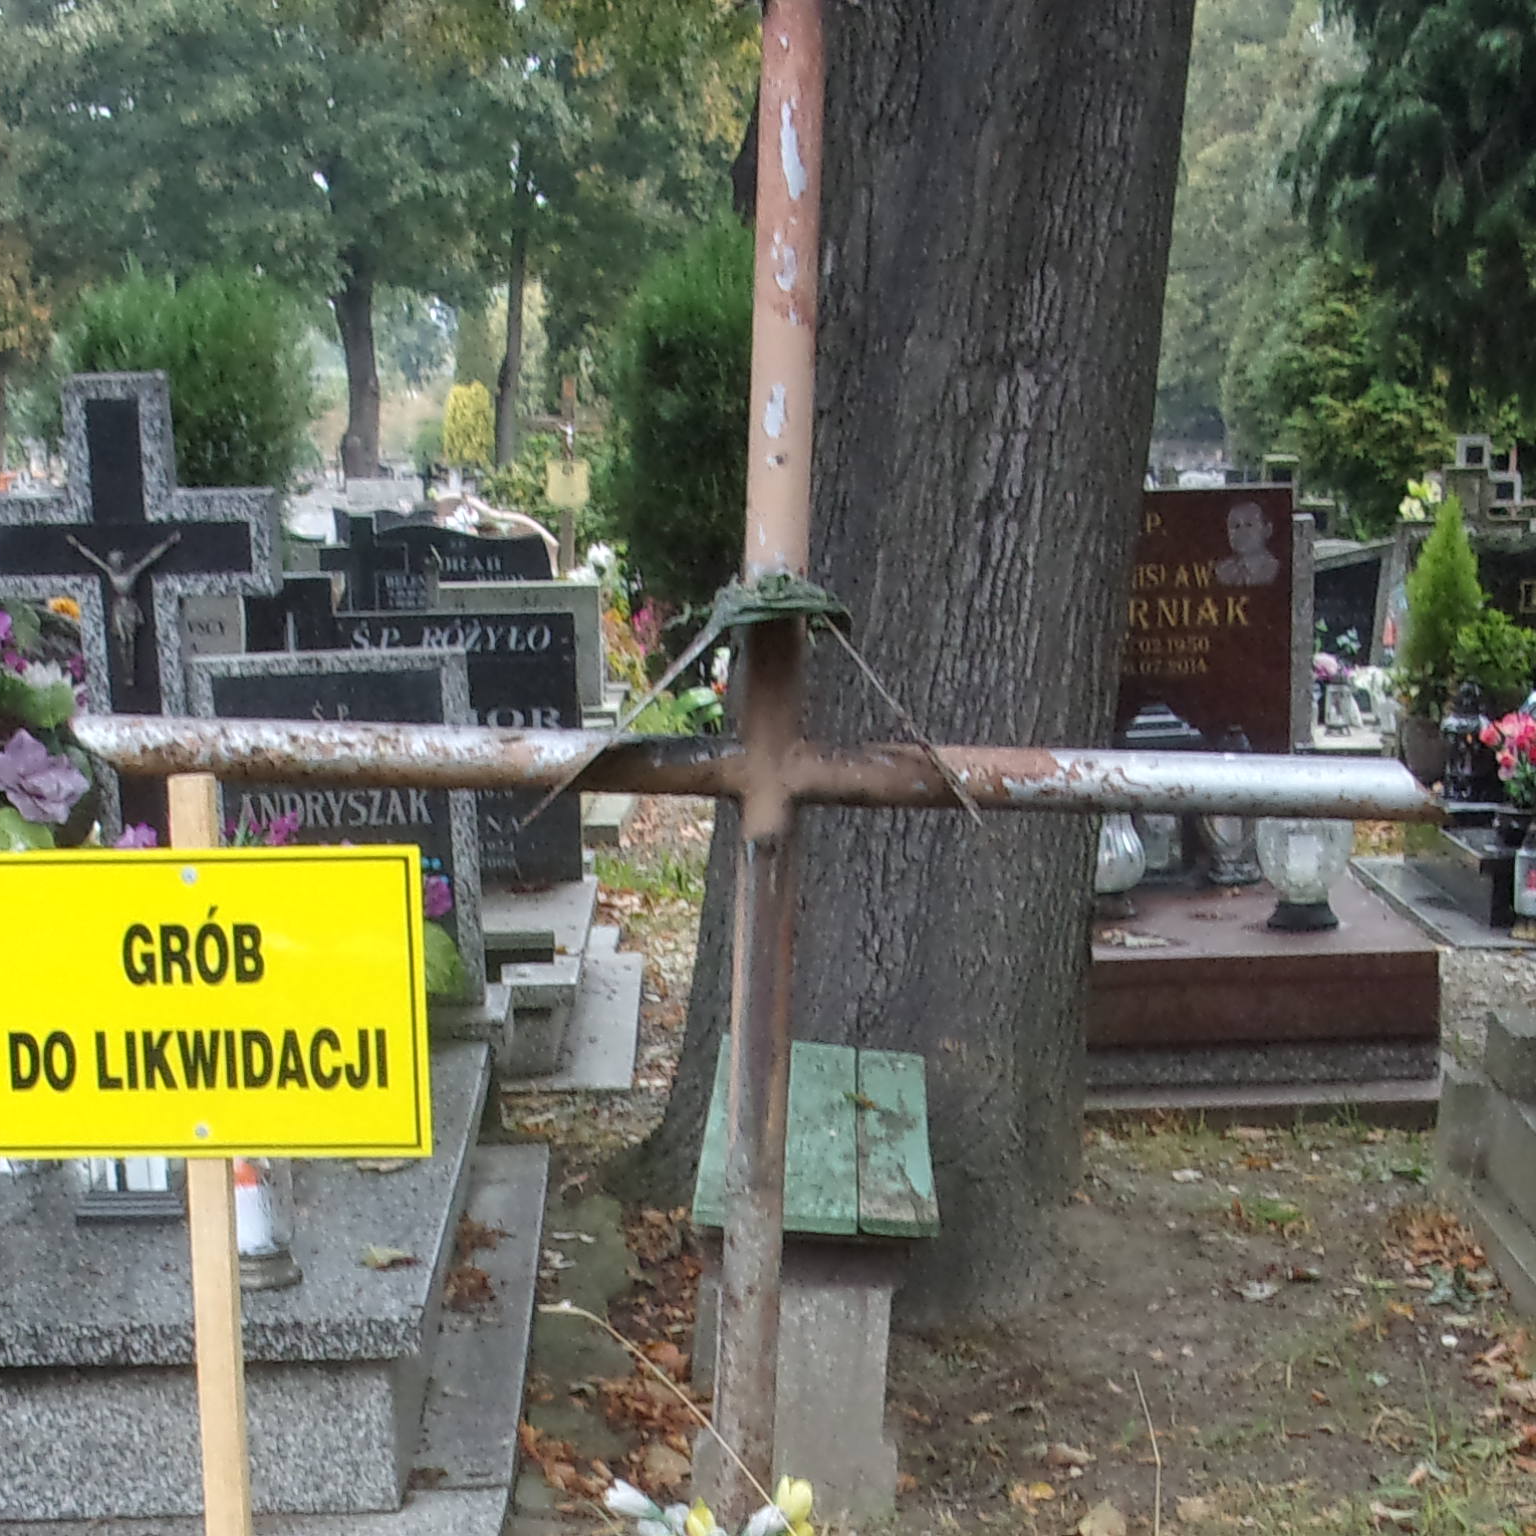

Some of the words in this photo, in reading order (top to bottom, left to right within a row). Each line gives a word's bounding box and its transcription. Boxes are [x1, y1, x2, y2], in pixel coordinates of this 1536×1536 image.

[240, 785, 433, 830] ANDRYSZAK
[122, 905, 265, 986] GRÓB
[8, 1031, 77, 1092] DO
[95, 1027, 390, 1091] LIKWIDACJI
